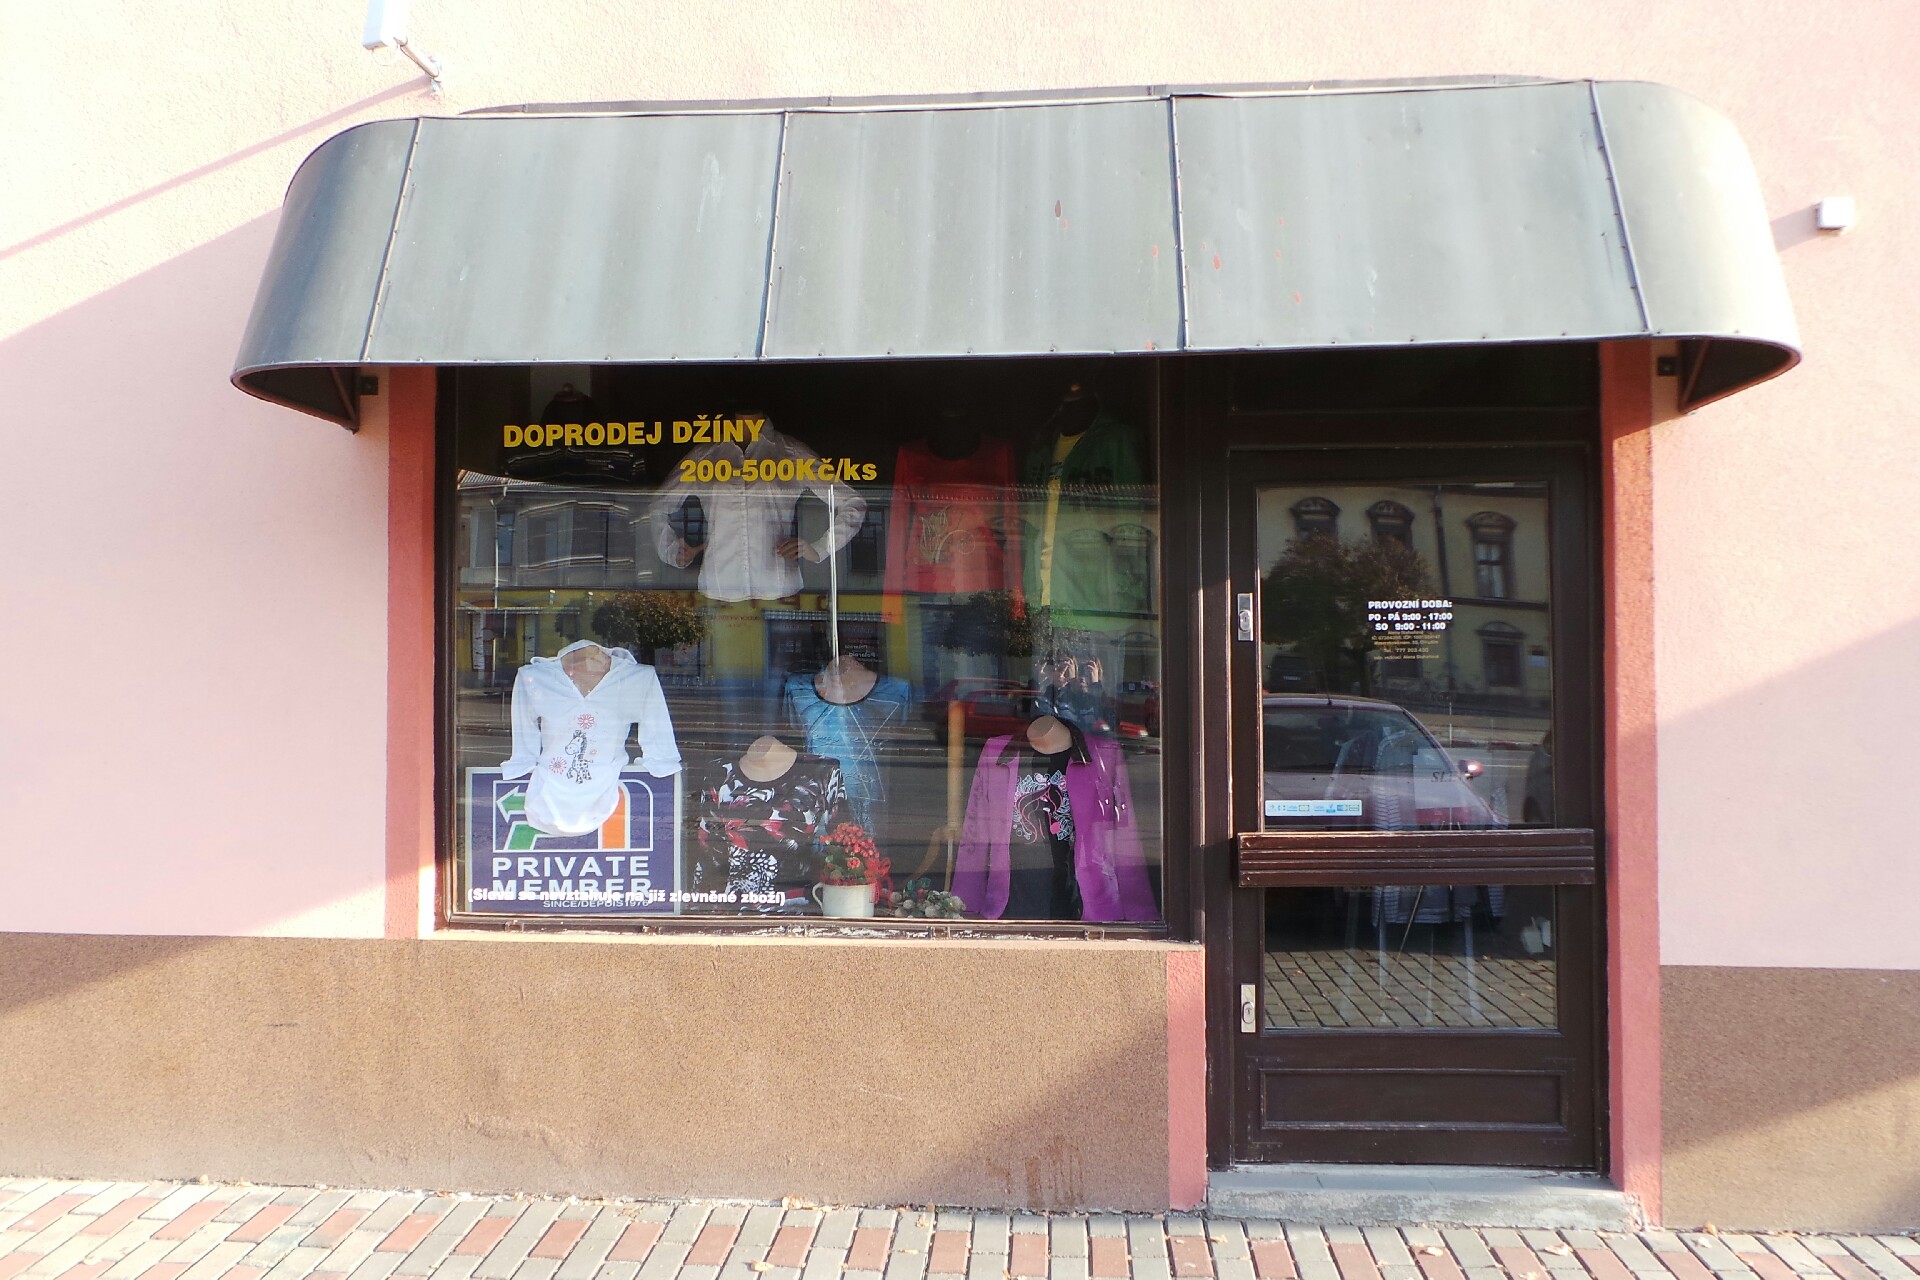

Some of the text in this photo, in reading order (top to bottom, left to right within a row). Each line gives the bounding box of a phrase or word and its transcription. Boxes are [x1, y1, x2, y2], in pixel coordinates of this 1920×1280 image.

[503, 414, 766, 448] DOPRODEJ DŽÍNY
[679, 458, 878, 483] 200-500Kč/ks
[1368, 599, 1452, 609] PROVOZNÍ DOBA:
[1368, 613, 1381, 621] PO
[1388, 612, 1400, 620] PÁ
[1422, 622, 1446, 630] 11:00
[492, 856, 650, 877] PRIVATE
[467, 888, 514, 902] (Sleva
[625, 892, 645, 901] na
[648, 890, 666, 904] již
[669, 890, 737, 903] zlevněné
[741, 890, 786, 906] zboží)
[492, 878, 651, 901] MEMBER
